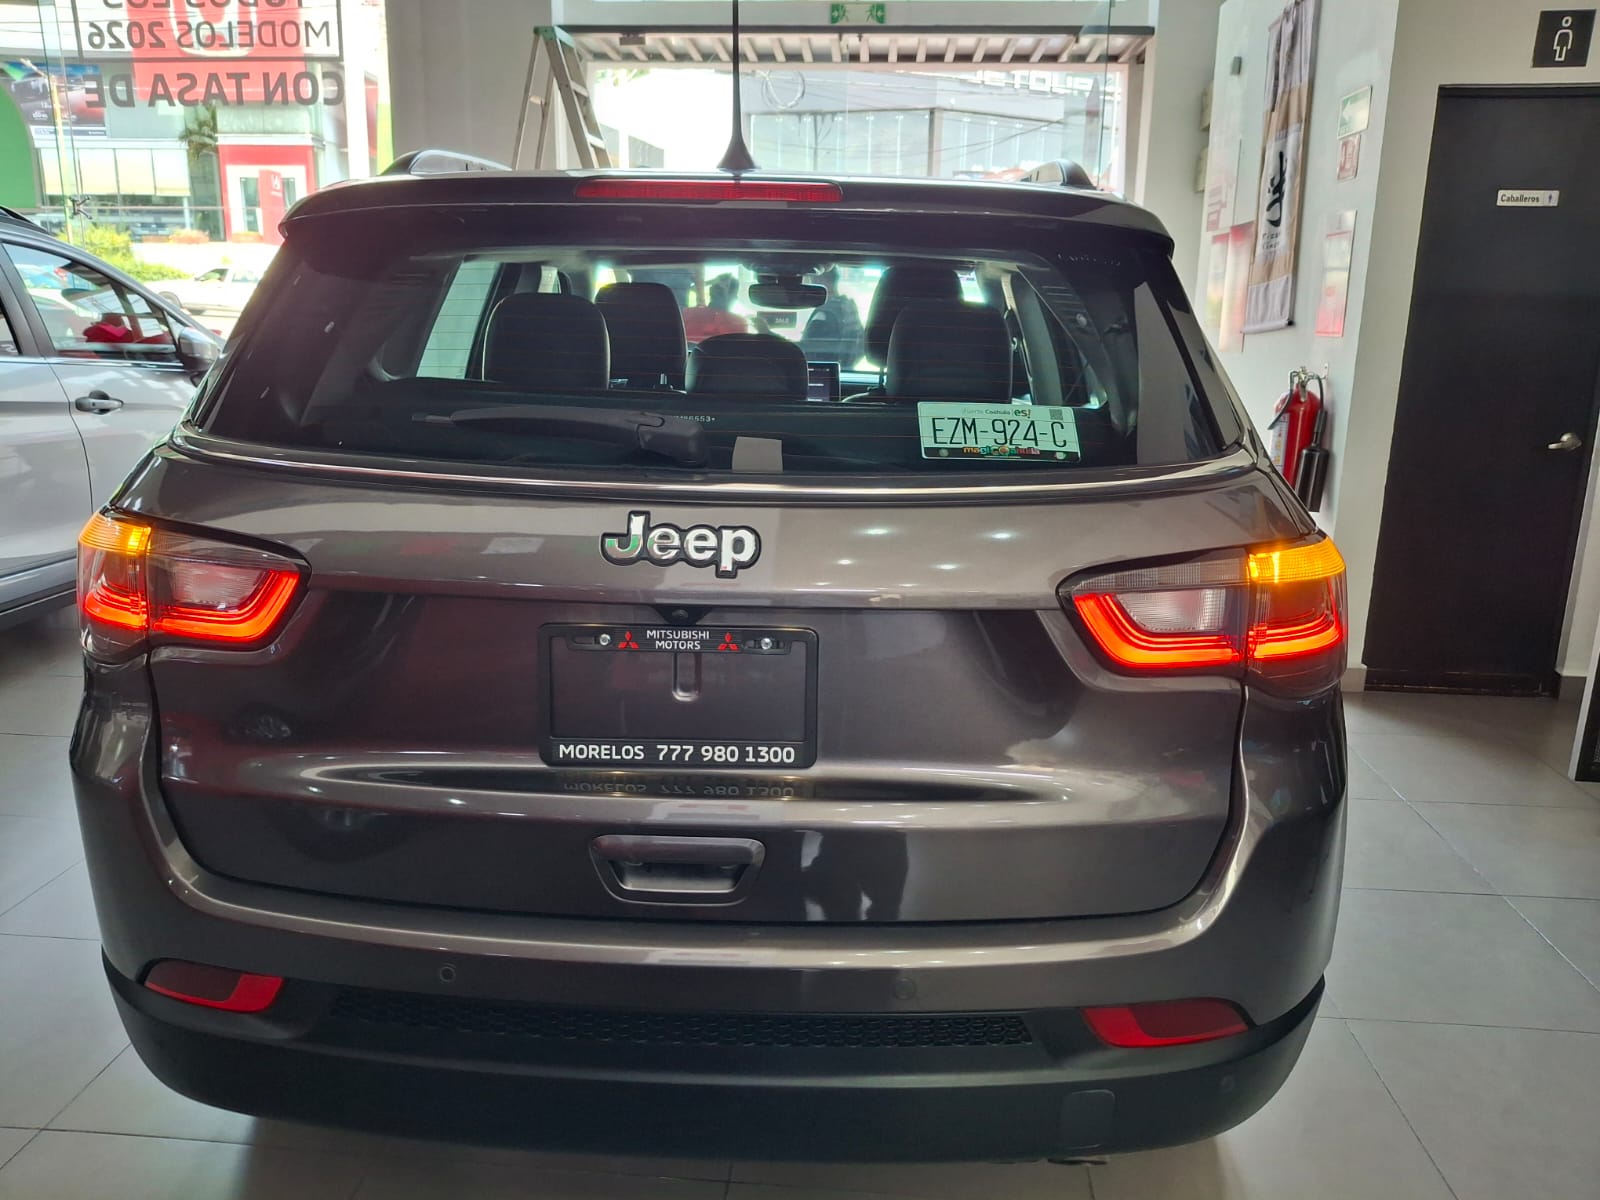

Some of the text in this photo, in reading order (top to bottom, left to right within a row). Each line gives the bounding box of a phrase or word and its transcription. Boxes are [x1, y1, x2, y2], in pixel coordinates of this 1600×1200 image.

[1500, 193, 1540, 203] Caballeros
[931, 417, 1067, 448] EZM-924-C
[602, 511, 760, 577] Jeep
[646, 629, 710, 640] MITSUBISHI
[655, 640, 701, 650] MOTORS
[559, 744, 795, 763] MORELOS 777 980 1300
